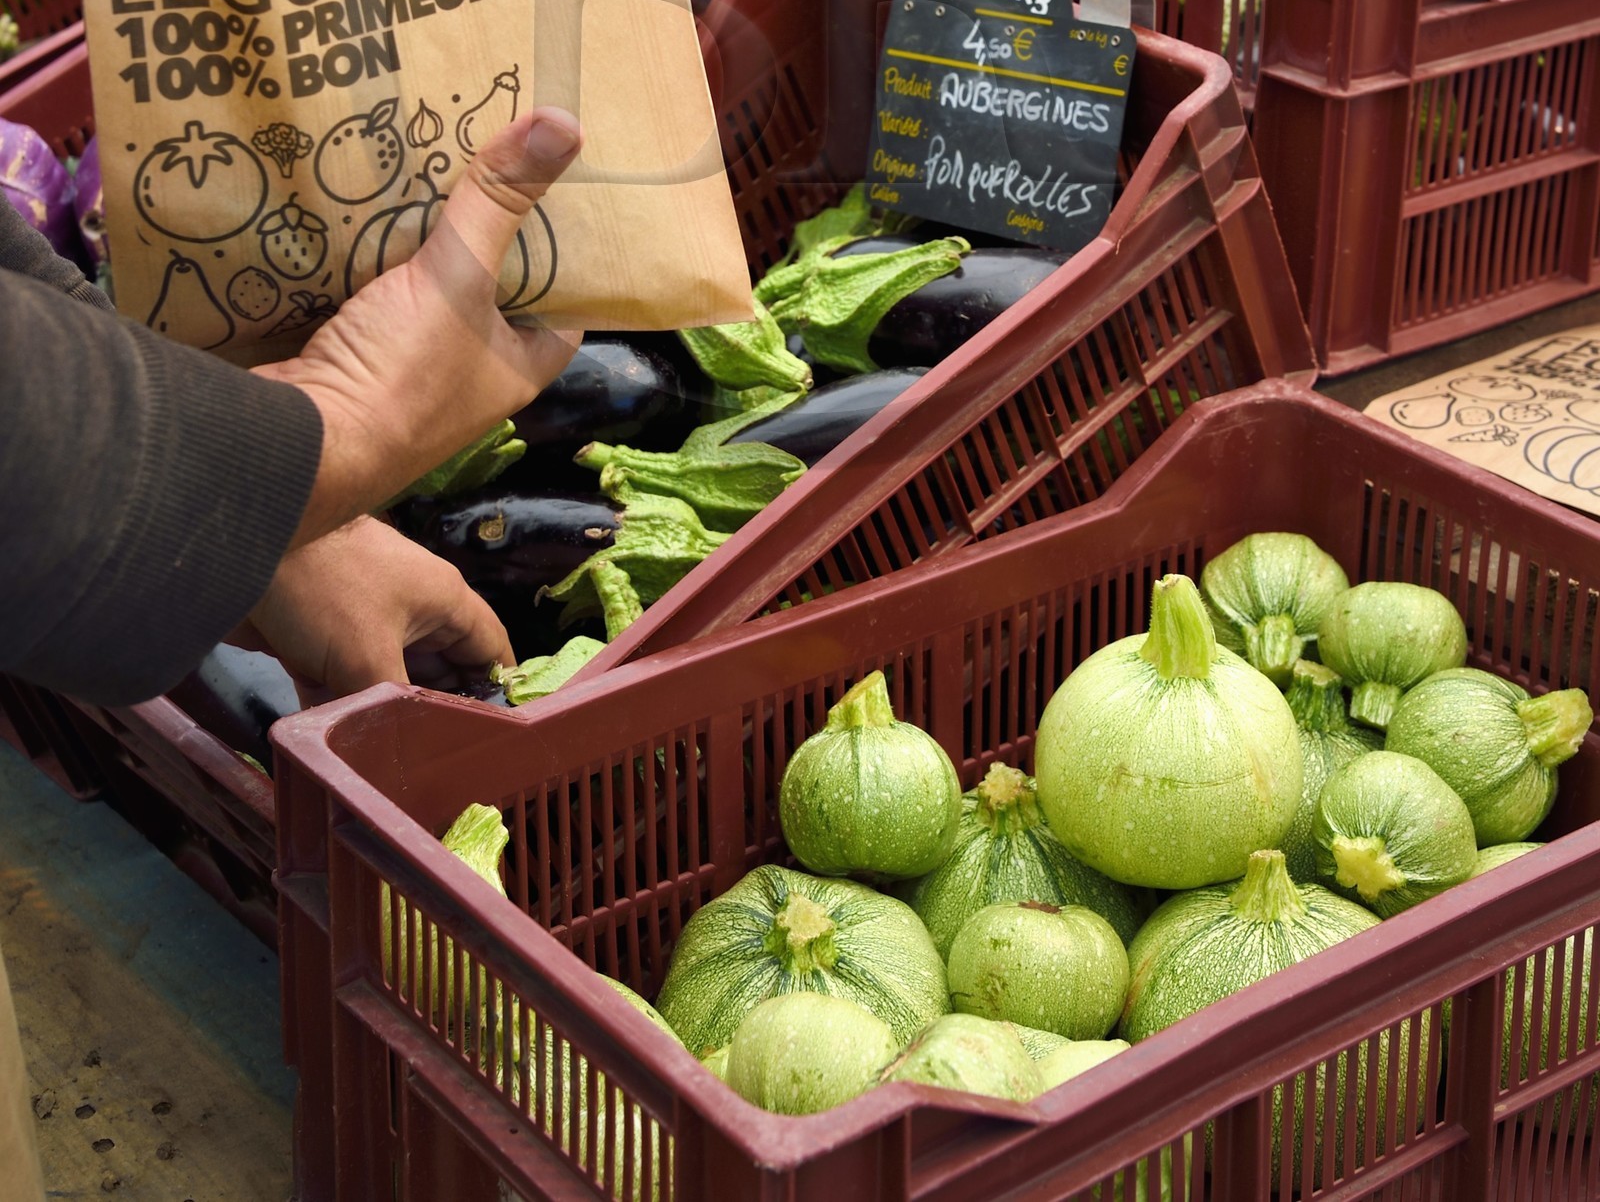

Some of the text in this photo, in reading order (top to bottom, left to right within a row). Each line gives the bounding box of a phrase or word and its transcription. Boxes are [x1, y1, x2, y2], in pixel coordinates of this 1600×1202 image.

[115, 11, 275, 59] 100%
[119, 31, 401, 103] 100% BON
[884, 67, 932, 99] Produit
[1114, 55, 1129, 76] €
[873, 148, 916, 183] Origine
